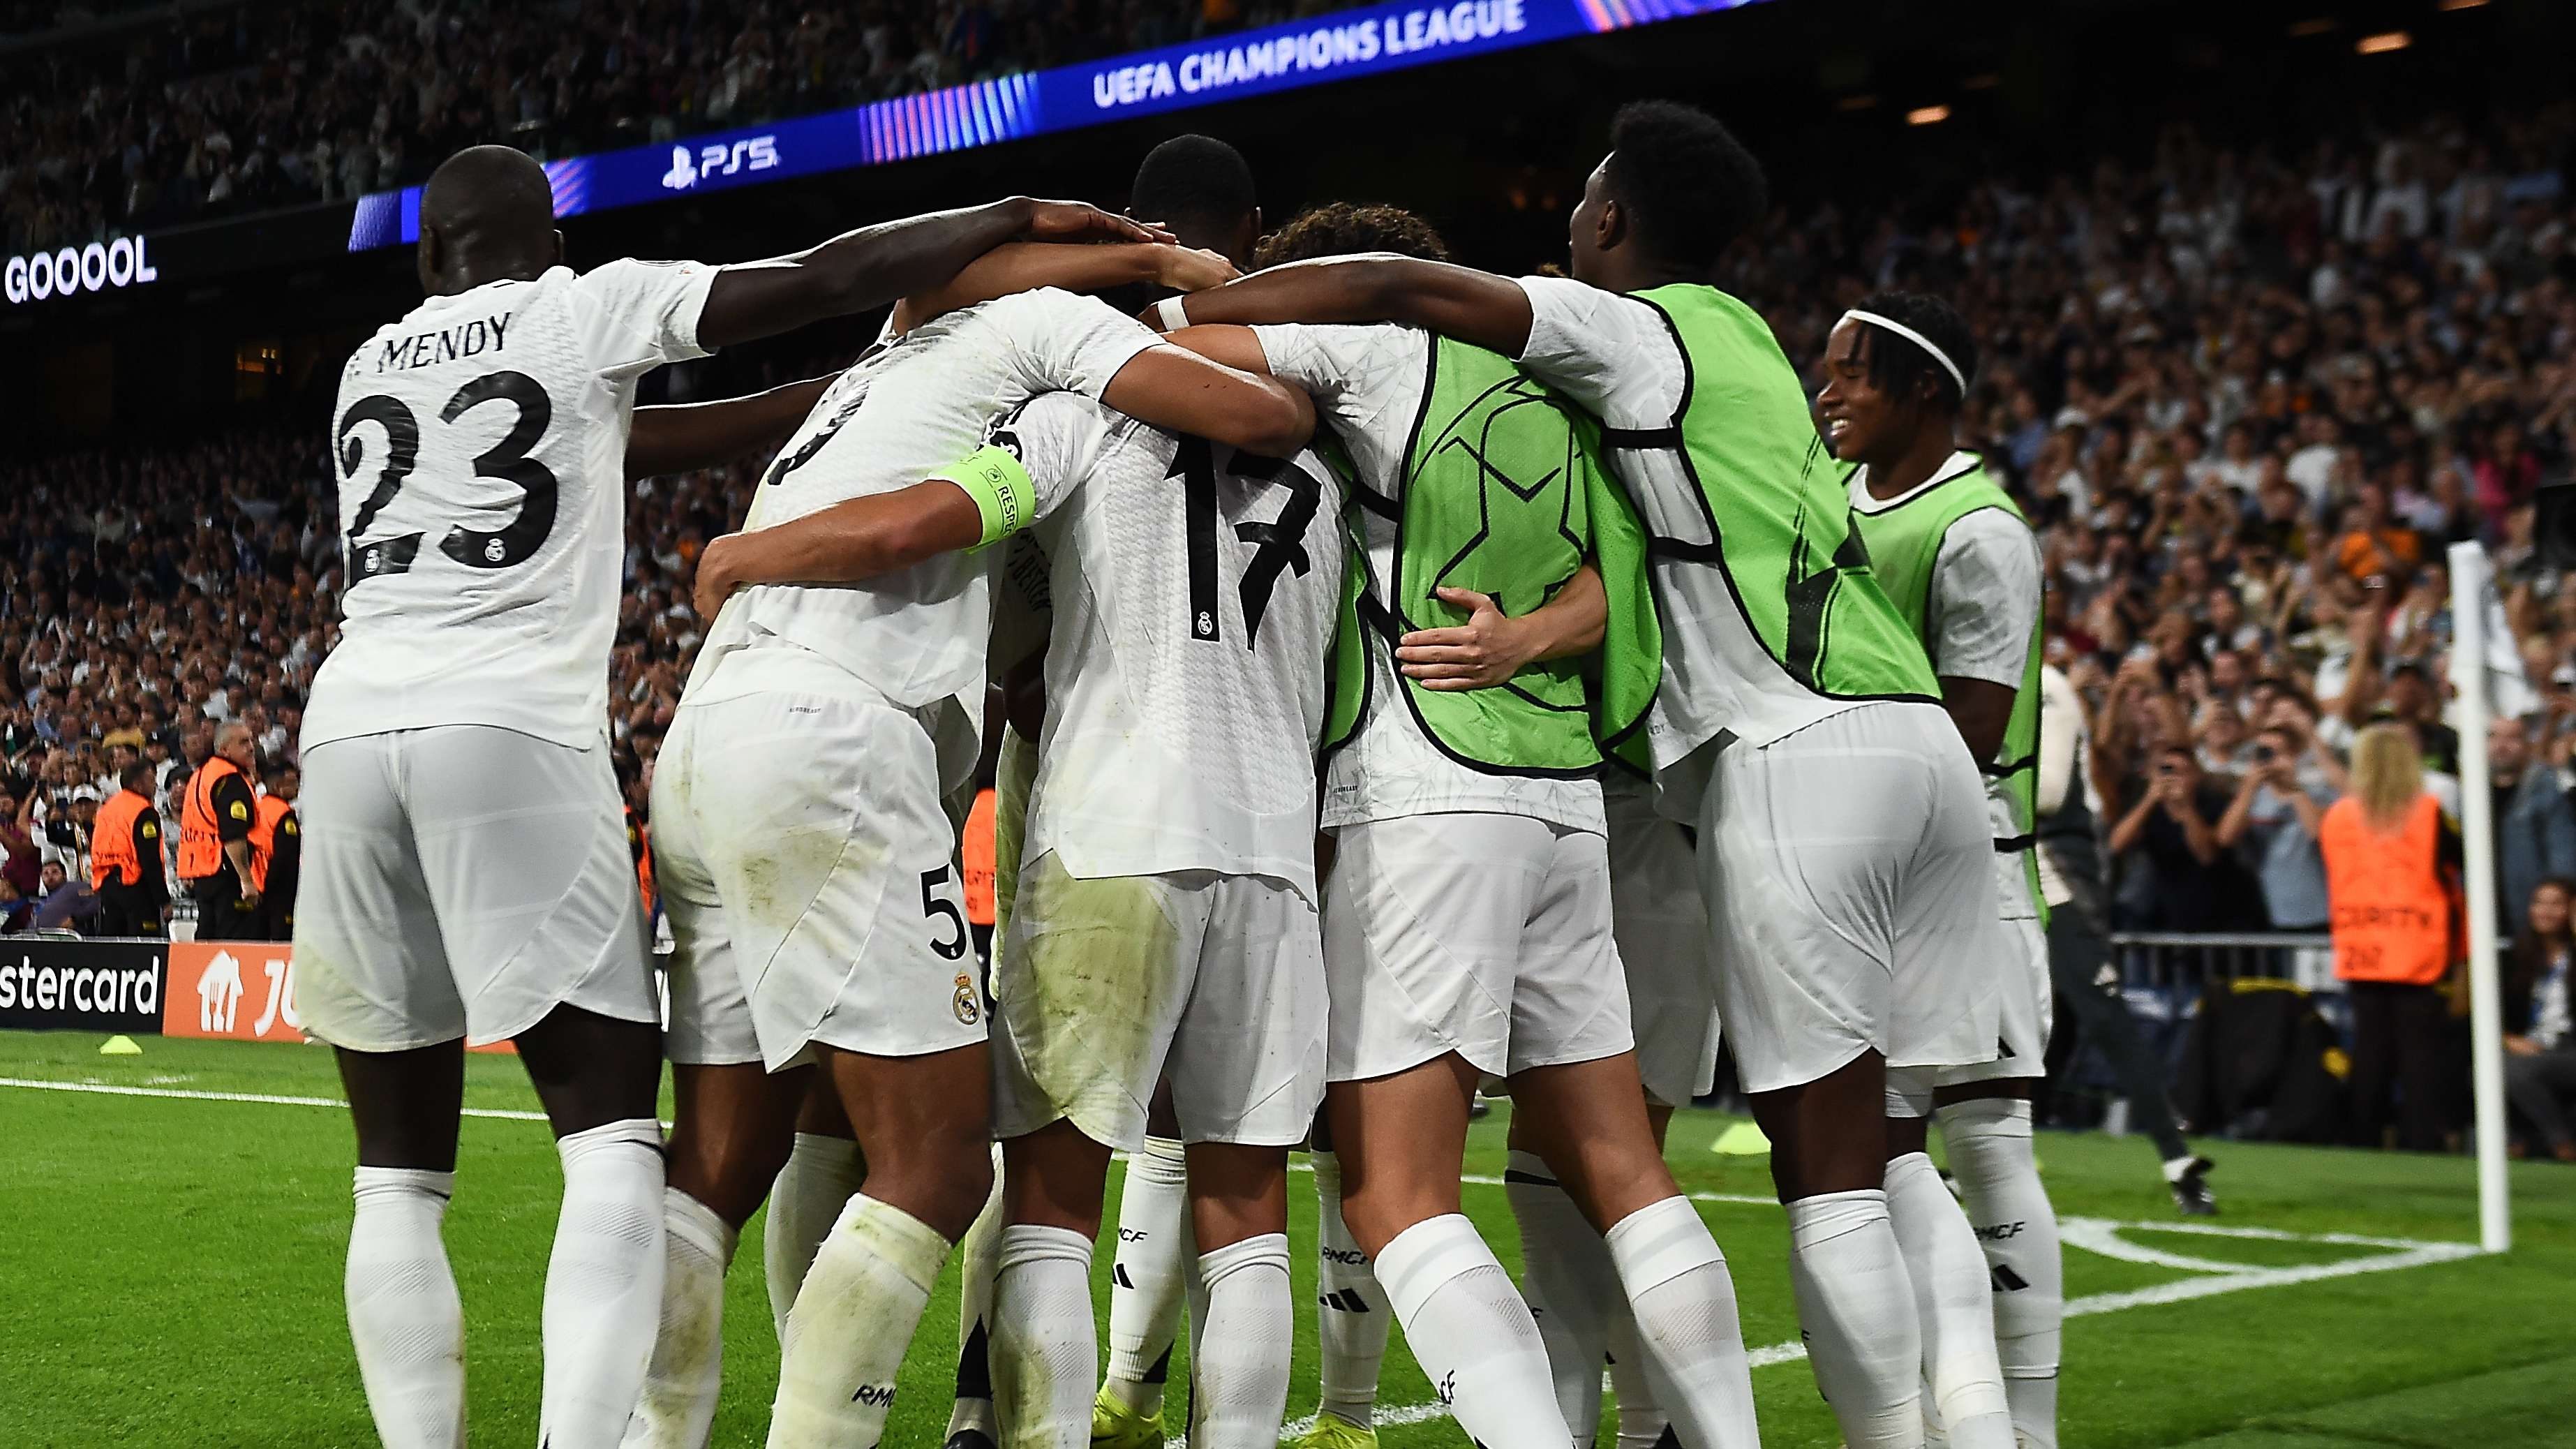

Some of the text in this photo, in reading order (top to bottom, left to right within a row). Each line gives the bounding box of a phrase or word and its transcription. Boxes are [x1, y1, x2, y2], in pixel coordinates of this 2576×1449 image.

[1094, 0, 1526, 109] UEFA CHAMPIONS LEAGUE
[701, 135, 777, 179] PS5
[5, 235, 157, 304] GOOOOL
[377, 312, 512, 373] MENDY
[338, 370, 558, 588] 23
[1163, 431, 1323, 656] 17
[920, 863, 967, 960] 5
[1119, 1227, 1148, 1242] CF
[851, 1384, 898, 1408] RM
[1439, 1369, 1455, 1405] CF
